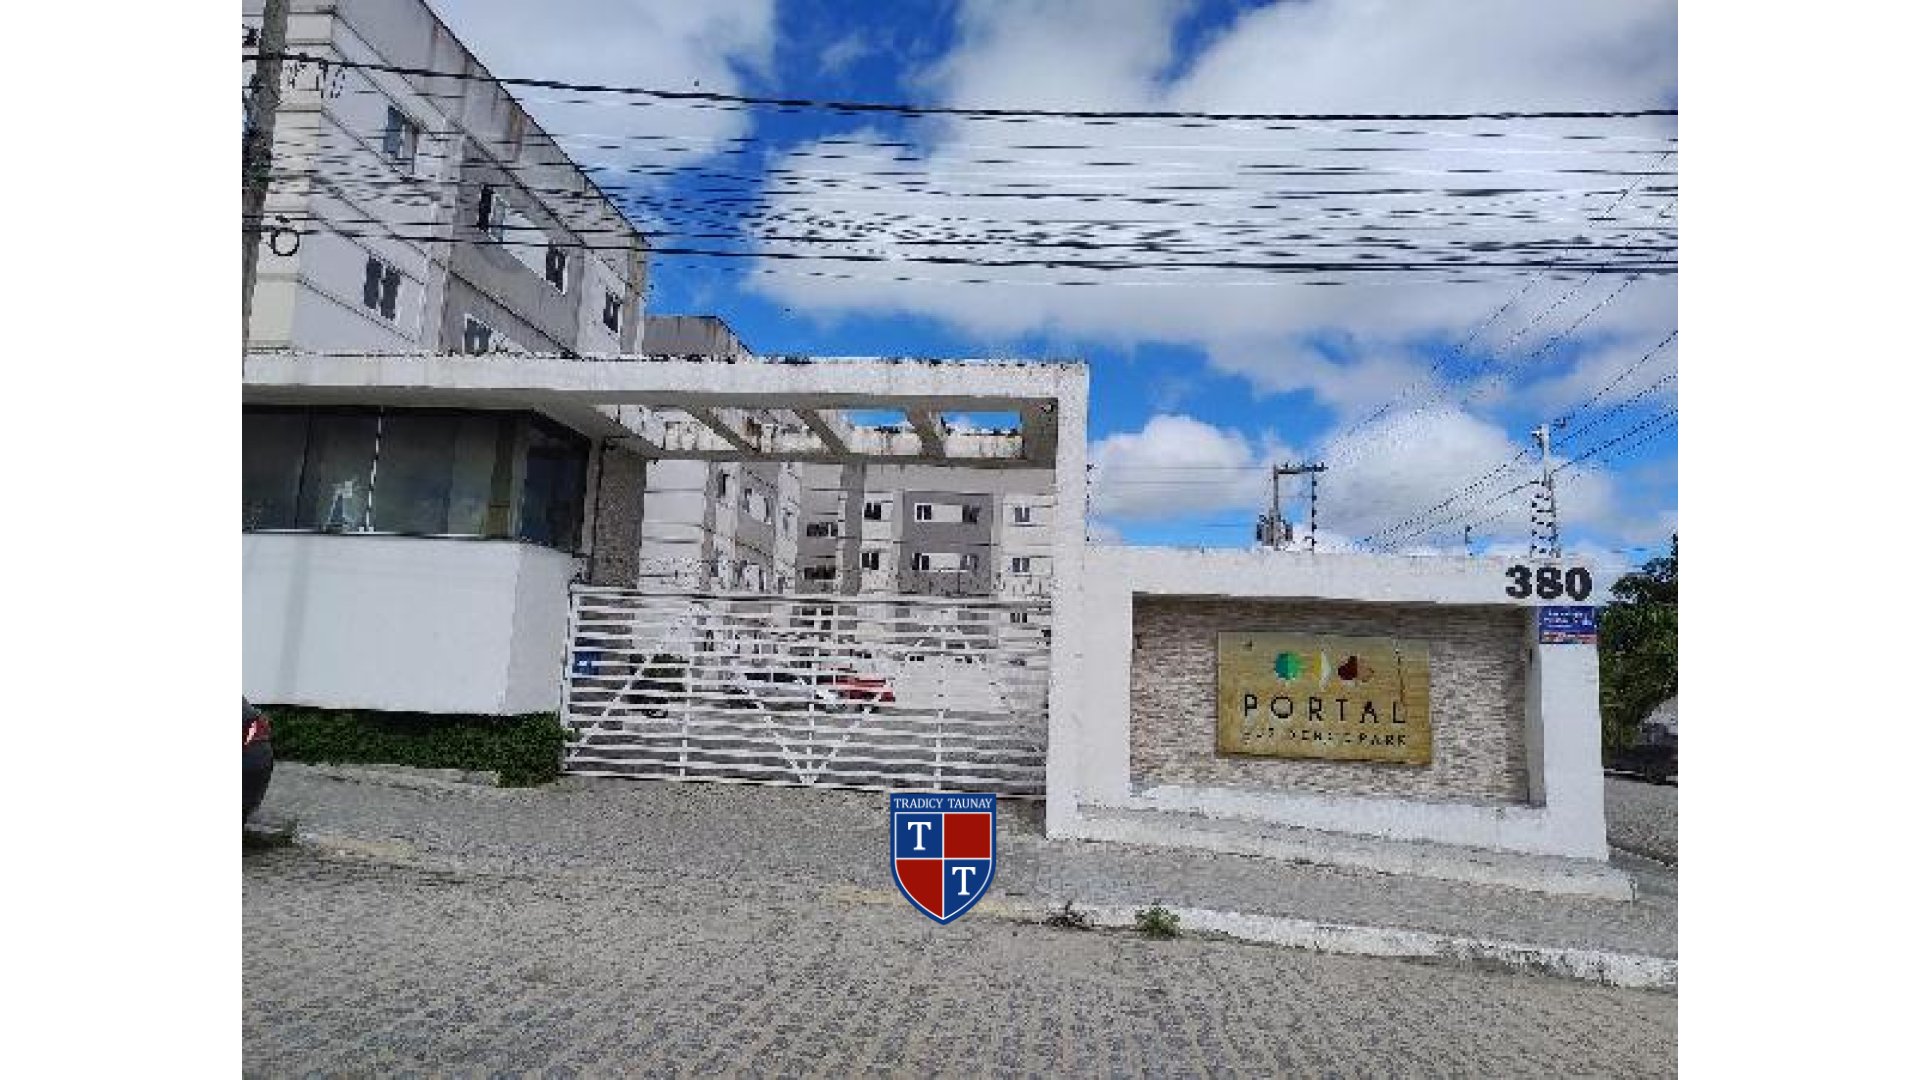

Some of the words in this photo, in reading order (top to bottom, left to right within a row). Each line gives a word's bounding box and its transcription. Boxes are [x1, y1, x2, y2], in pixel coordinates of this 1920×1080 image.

[1505, 564, 1593, 601] 380
[1244, 693, 1406, 724] PORTAL
[1359, 732, 1406, 746] PARK
